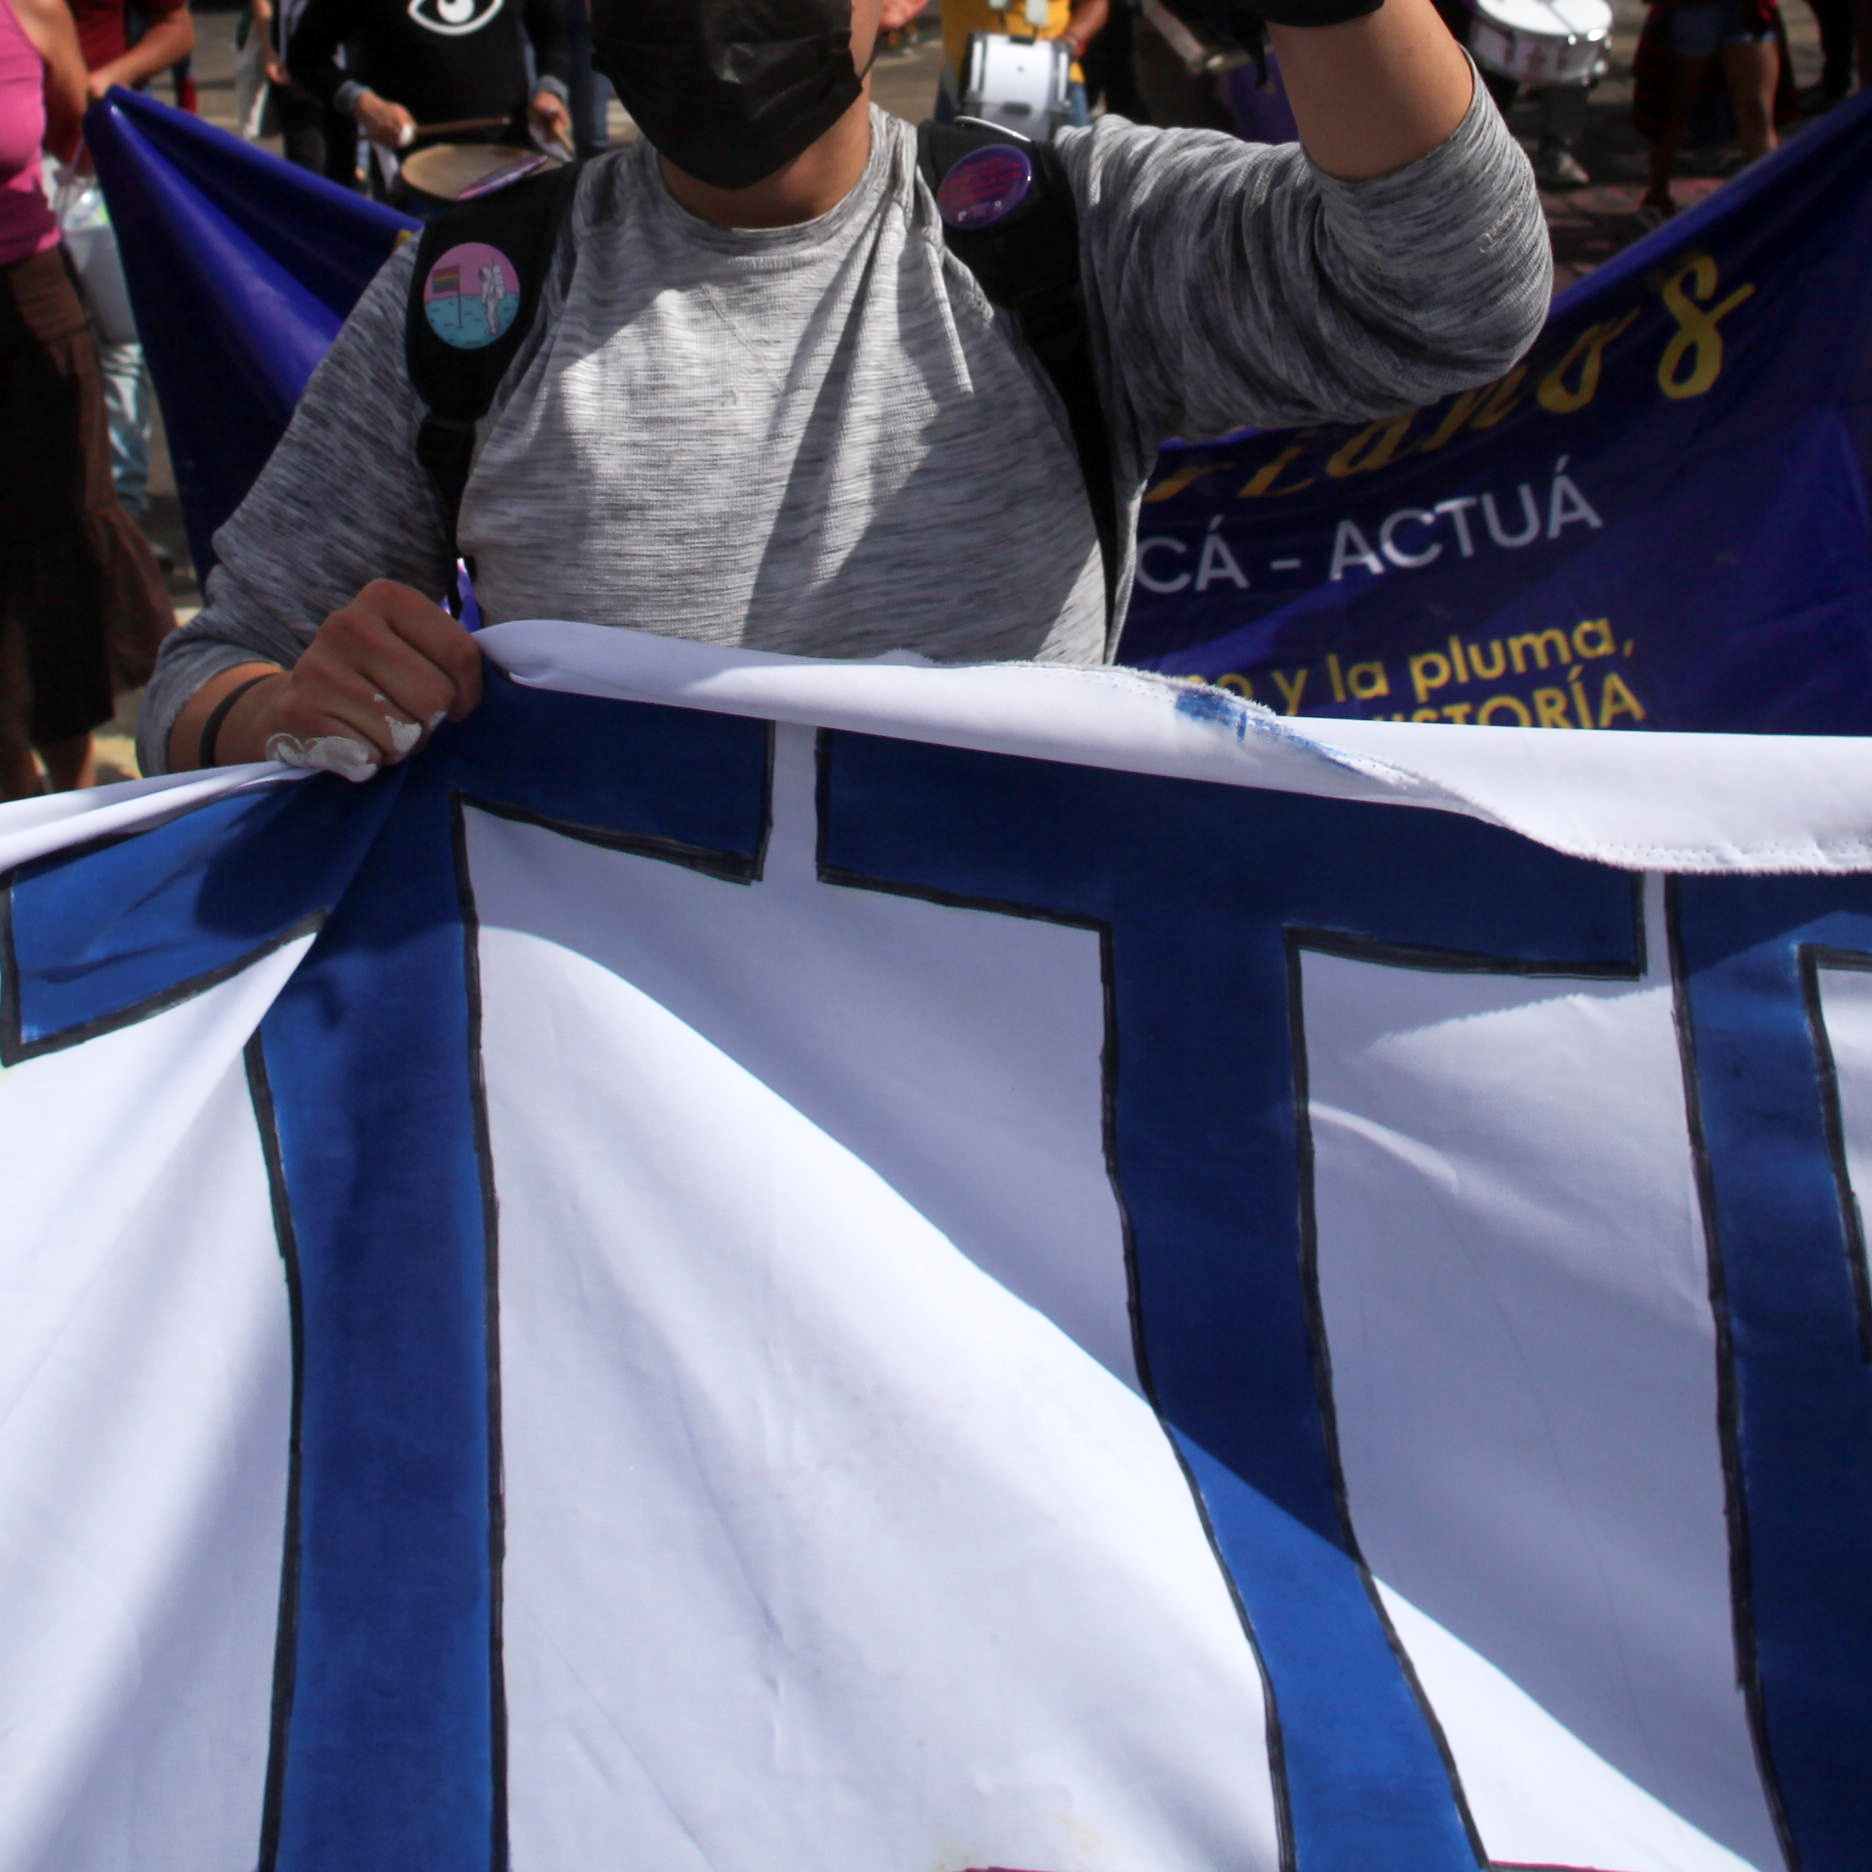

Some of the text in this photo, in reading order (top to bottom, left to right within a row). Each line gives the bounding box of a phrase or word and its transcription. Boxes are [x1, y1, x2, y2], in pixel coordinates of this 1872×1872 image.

[1328, 453, 1604, 582] ACTUÁ
[1326, 652, 1391, 704] la
[1407, 616, 1638, 704] pluma,
